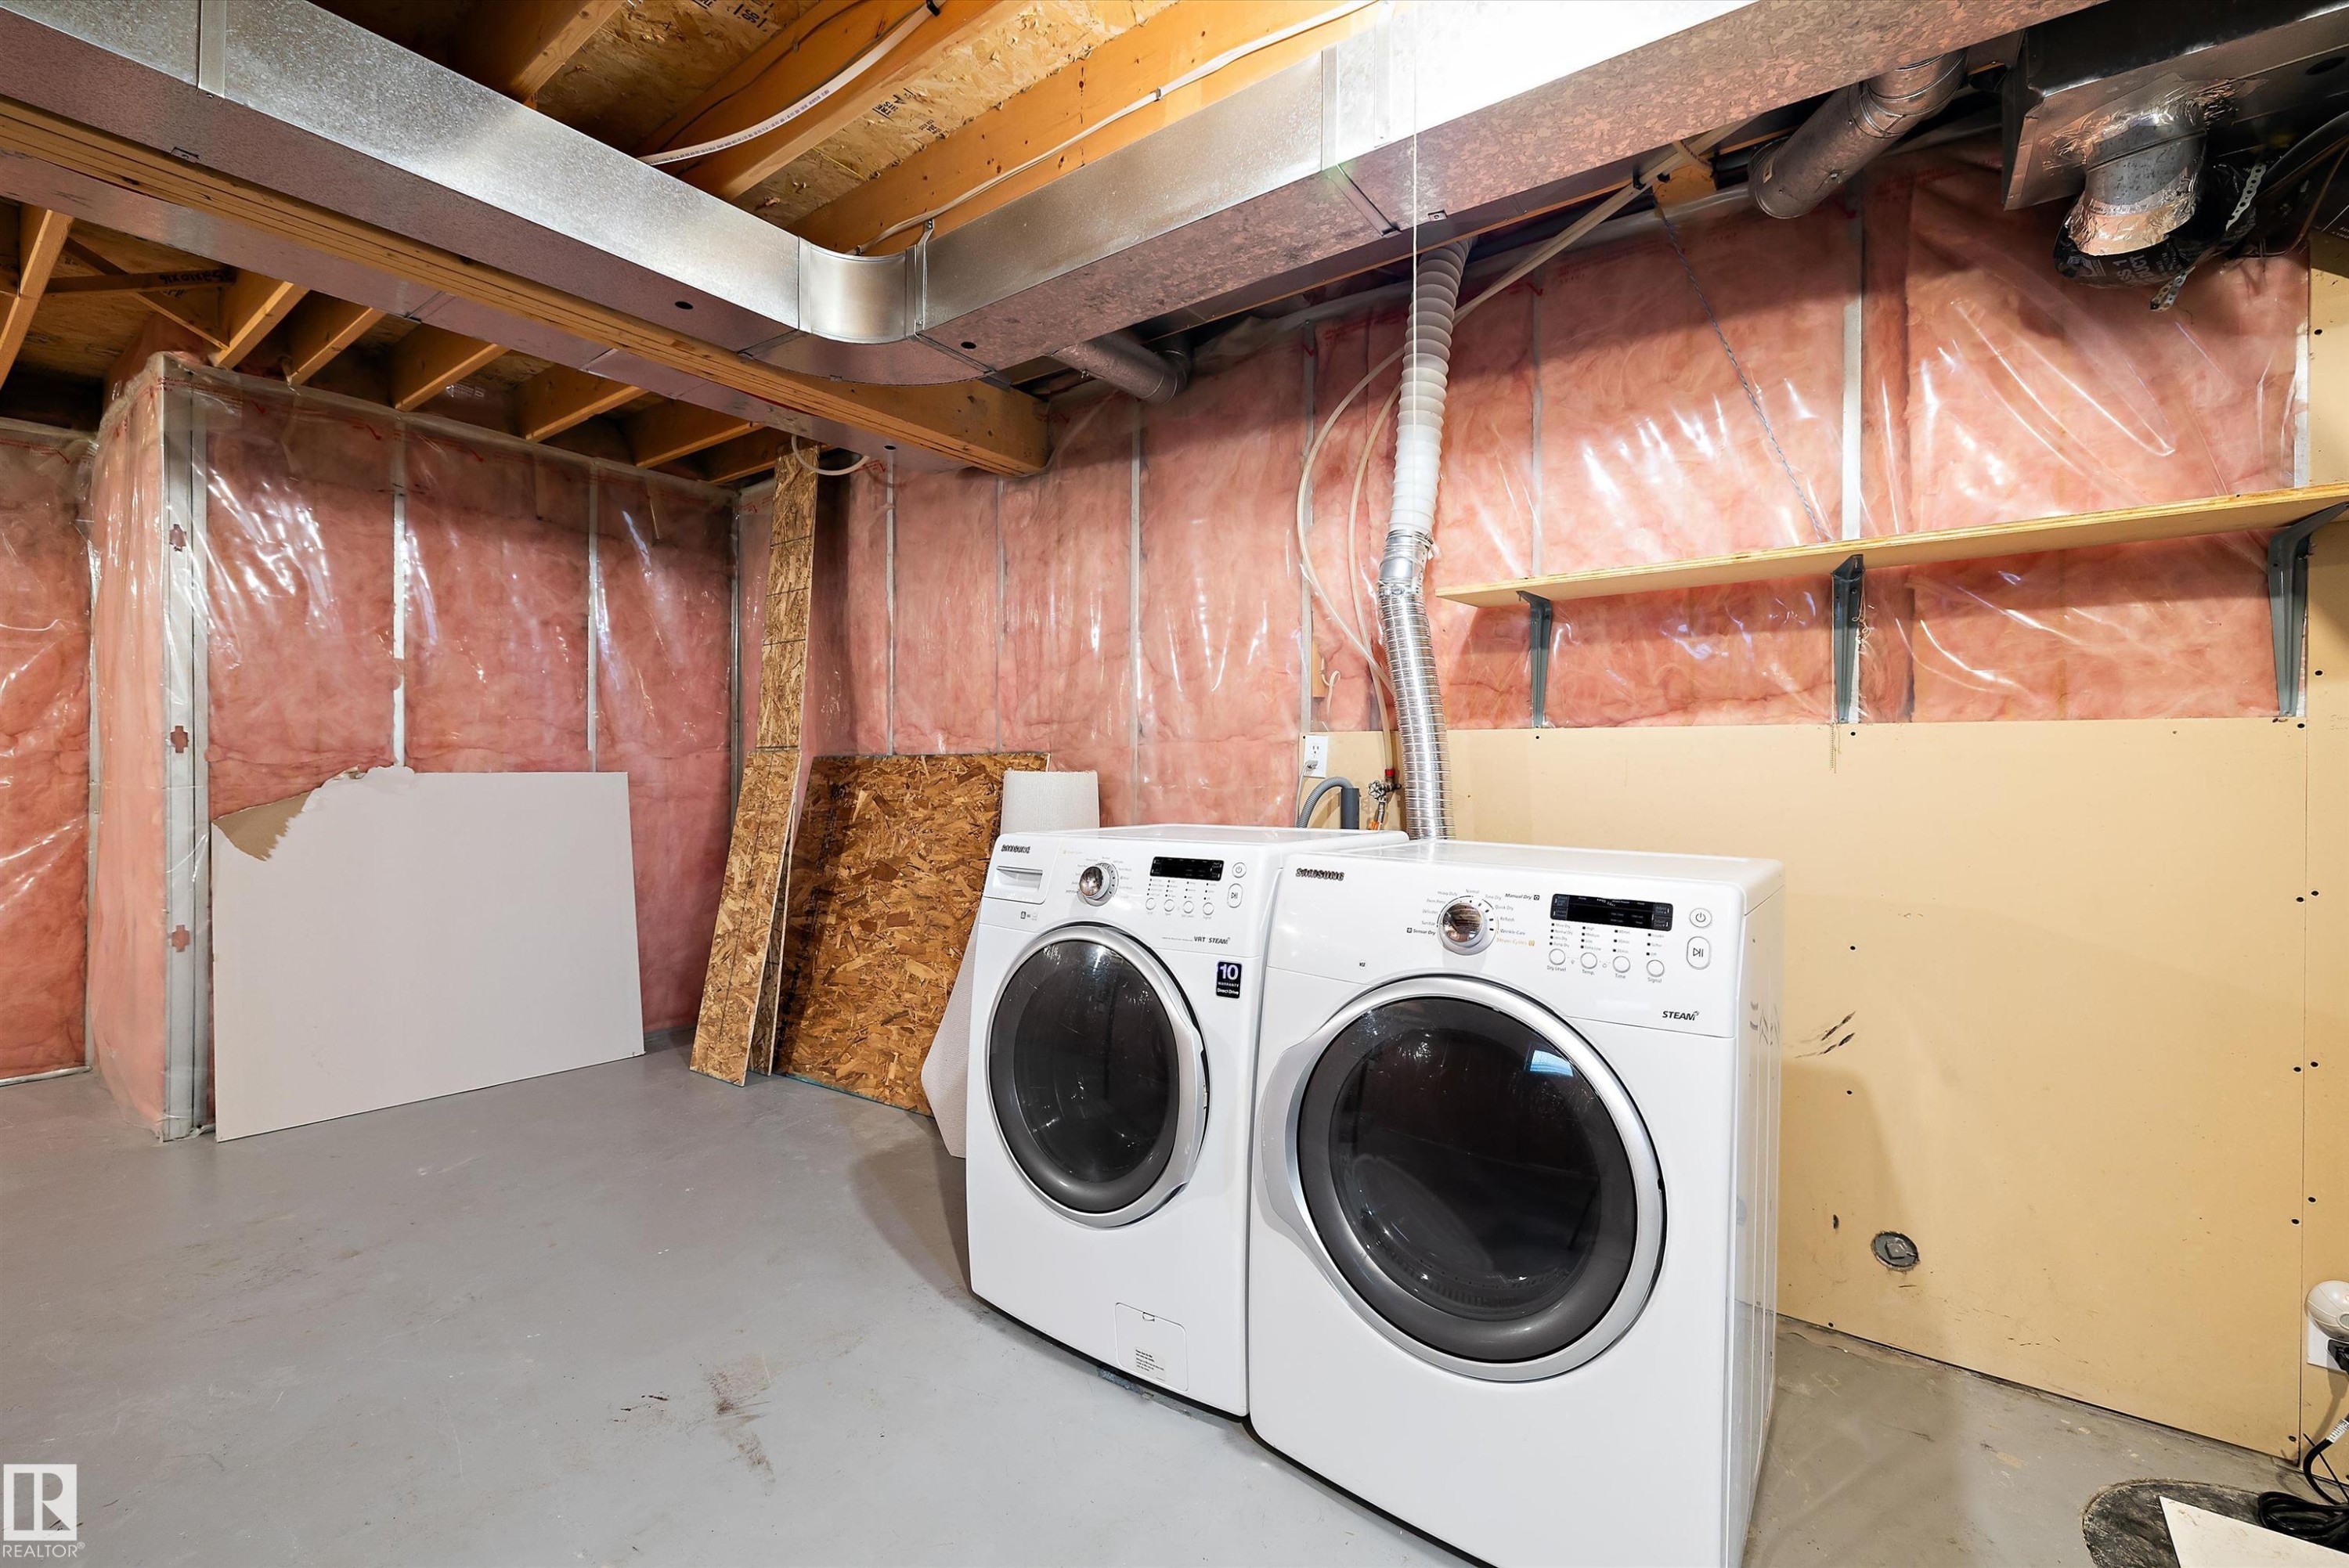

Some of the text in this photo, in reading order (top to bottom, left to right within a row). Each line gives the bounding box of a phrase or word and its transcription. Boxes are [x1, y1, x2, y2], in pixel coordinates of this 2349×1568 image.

[1296, 868, 1344, 881] SAMSUNG
[1220, 964, 1239, 980] 10
[1662, 1011, 1696, 1021] STEAM
